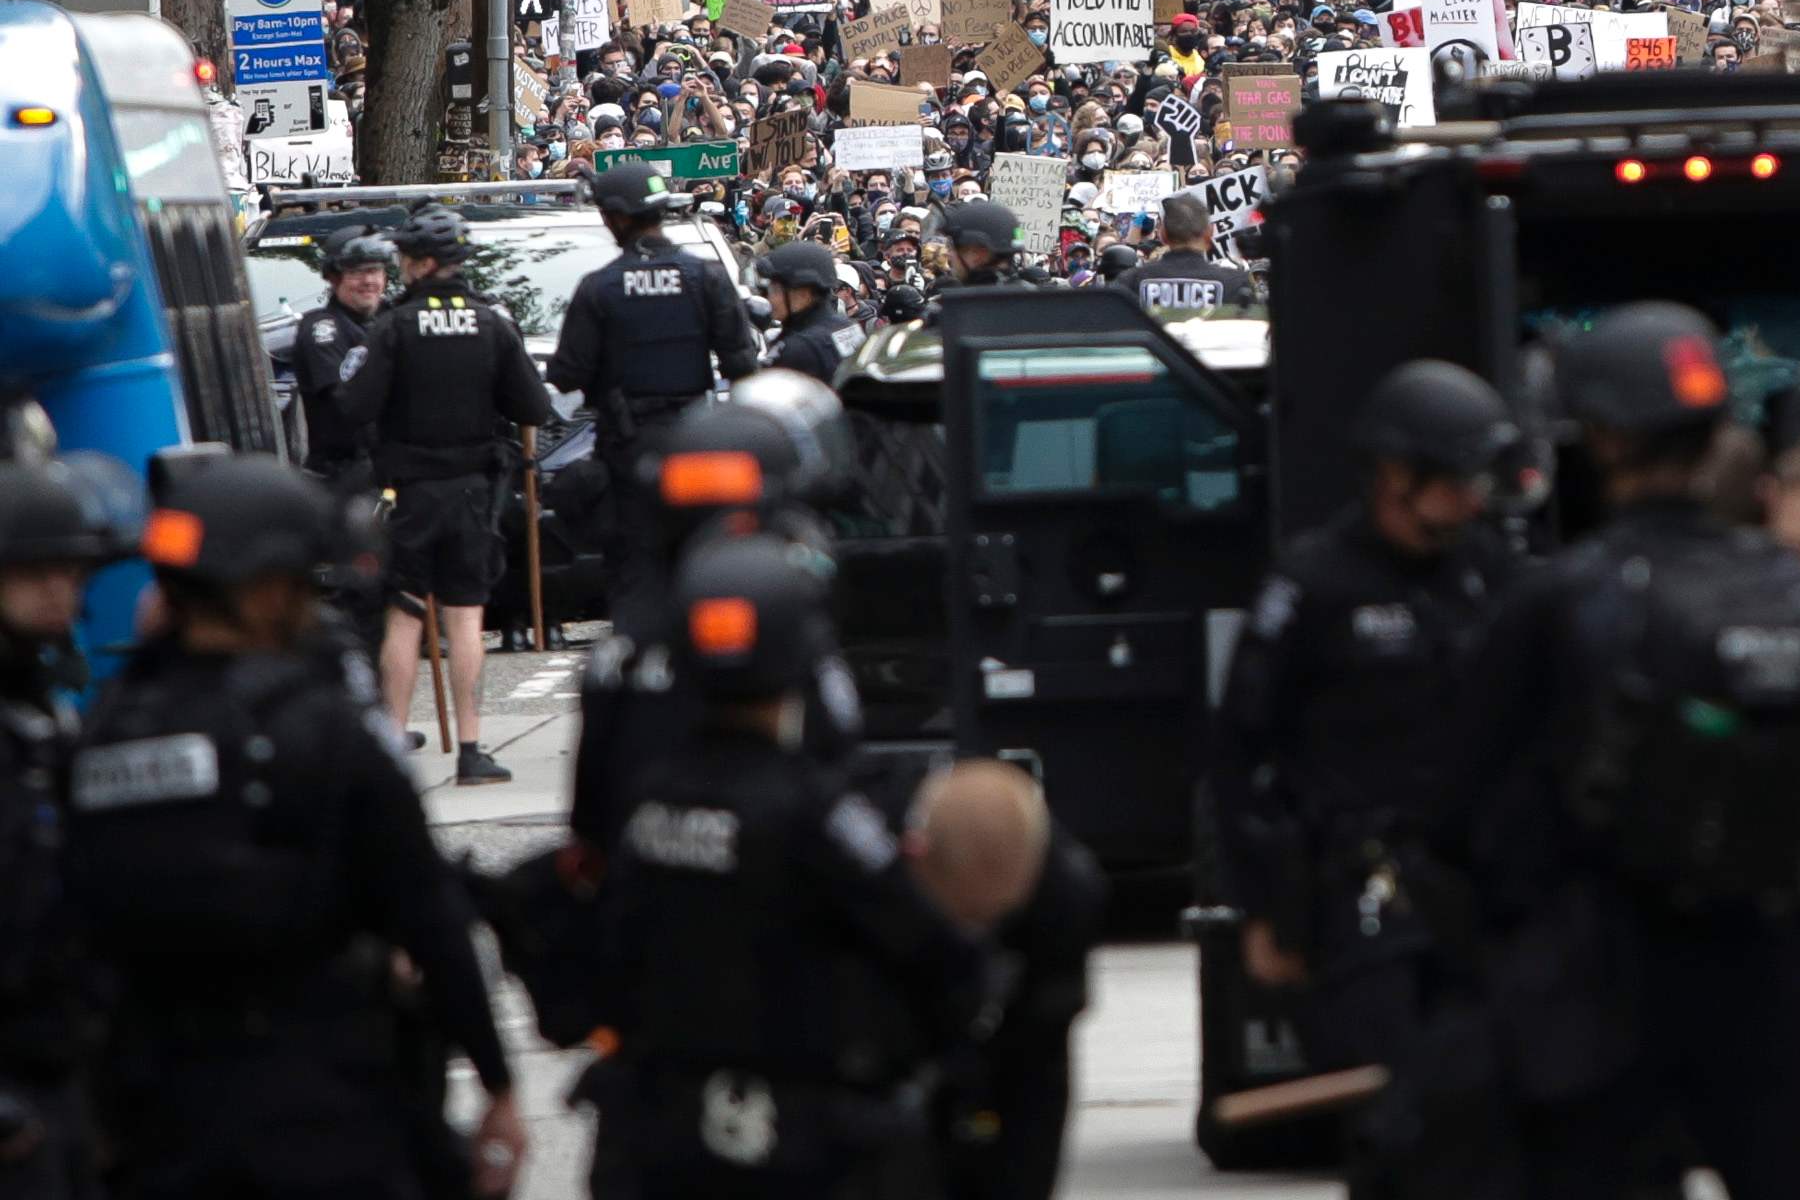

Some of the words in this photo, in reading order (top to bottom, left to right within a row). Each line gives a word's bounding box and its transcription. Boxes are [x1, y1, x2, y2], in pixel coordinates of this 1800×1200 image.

[235, 20, 256, 32] Pay
[258, 16, 319, 31] 8am-10pm
[844, 19, 869, 40] END
[872, 6, 909, 31] POLICE
[1430, 9, 1479, 23] MATTER
[1051, 20, 1154, 49] ACCOUNTABLE
[239, 53, 250, 70] 2
[253, 56, 292, 68] Hours
[294, 55, 322, 66] Max
[1349, 67, 1399, 87] CAN'T
[1234, 90, 1262, 105] TEAR
[1267, 90, 1292, 105] GAS
[751, 123, 760, 147] I
[765, 112, 808, 140] STAND
[1232, 125, 1253, 142] THE
[1258, 124, 1291, 143] POIN
[698, 152, 732, 170] Ave
[775, 136, 807, 167] YOU
[255, 150, 298, 182] Black
[999, 159, 1024, 174] AN
[1203, 173, 1264, 214] ACK
[623, 268, 681, 296] POLICE
[1150, 283, 1216, 307] POLICE
[418, 307, 478, 336] POLICE
